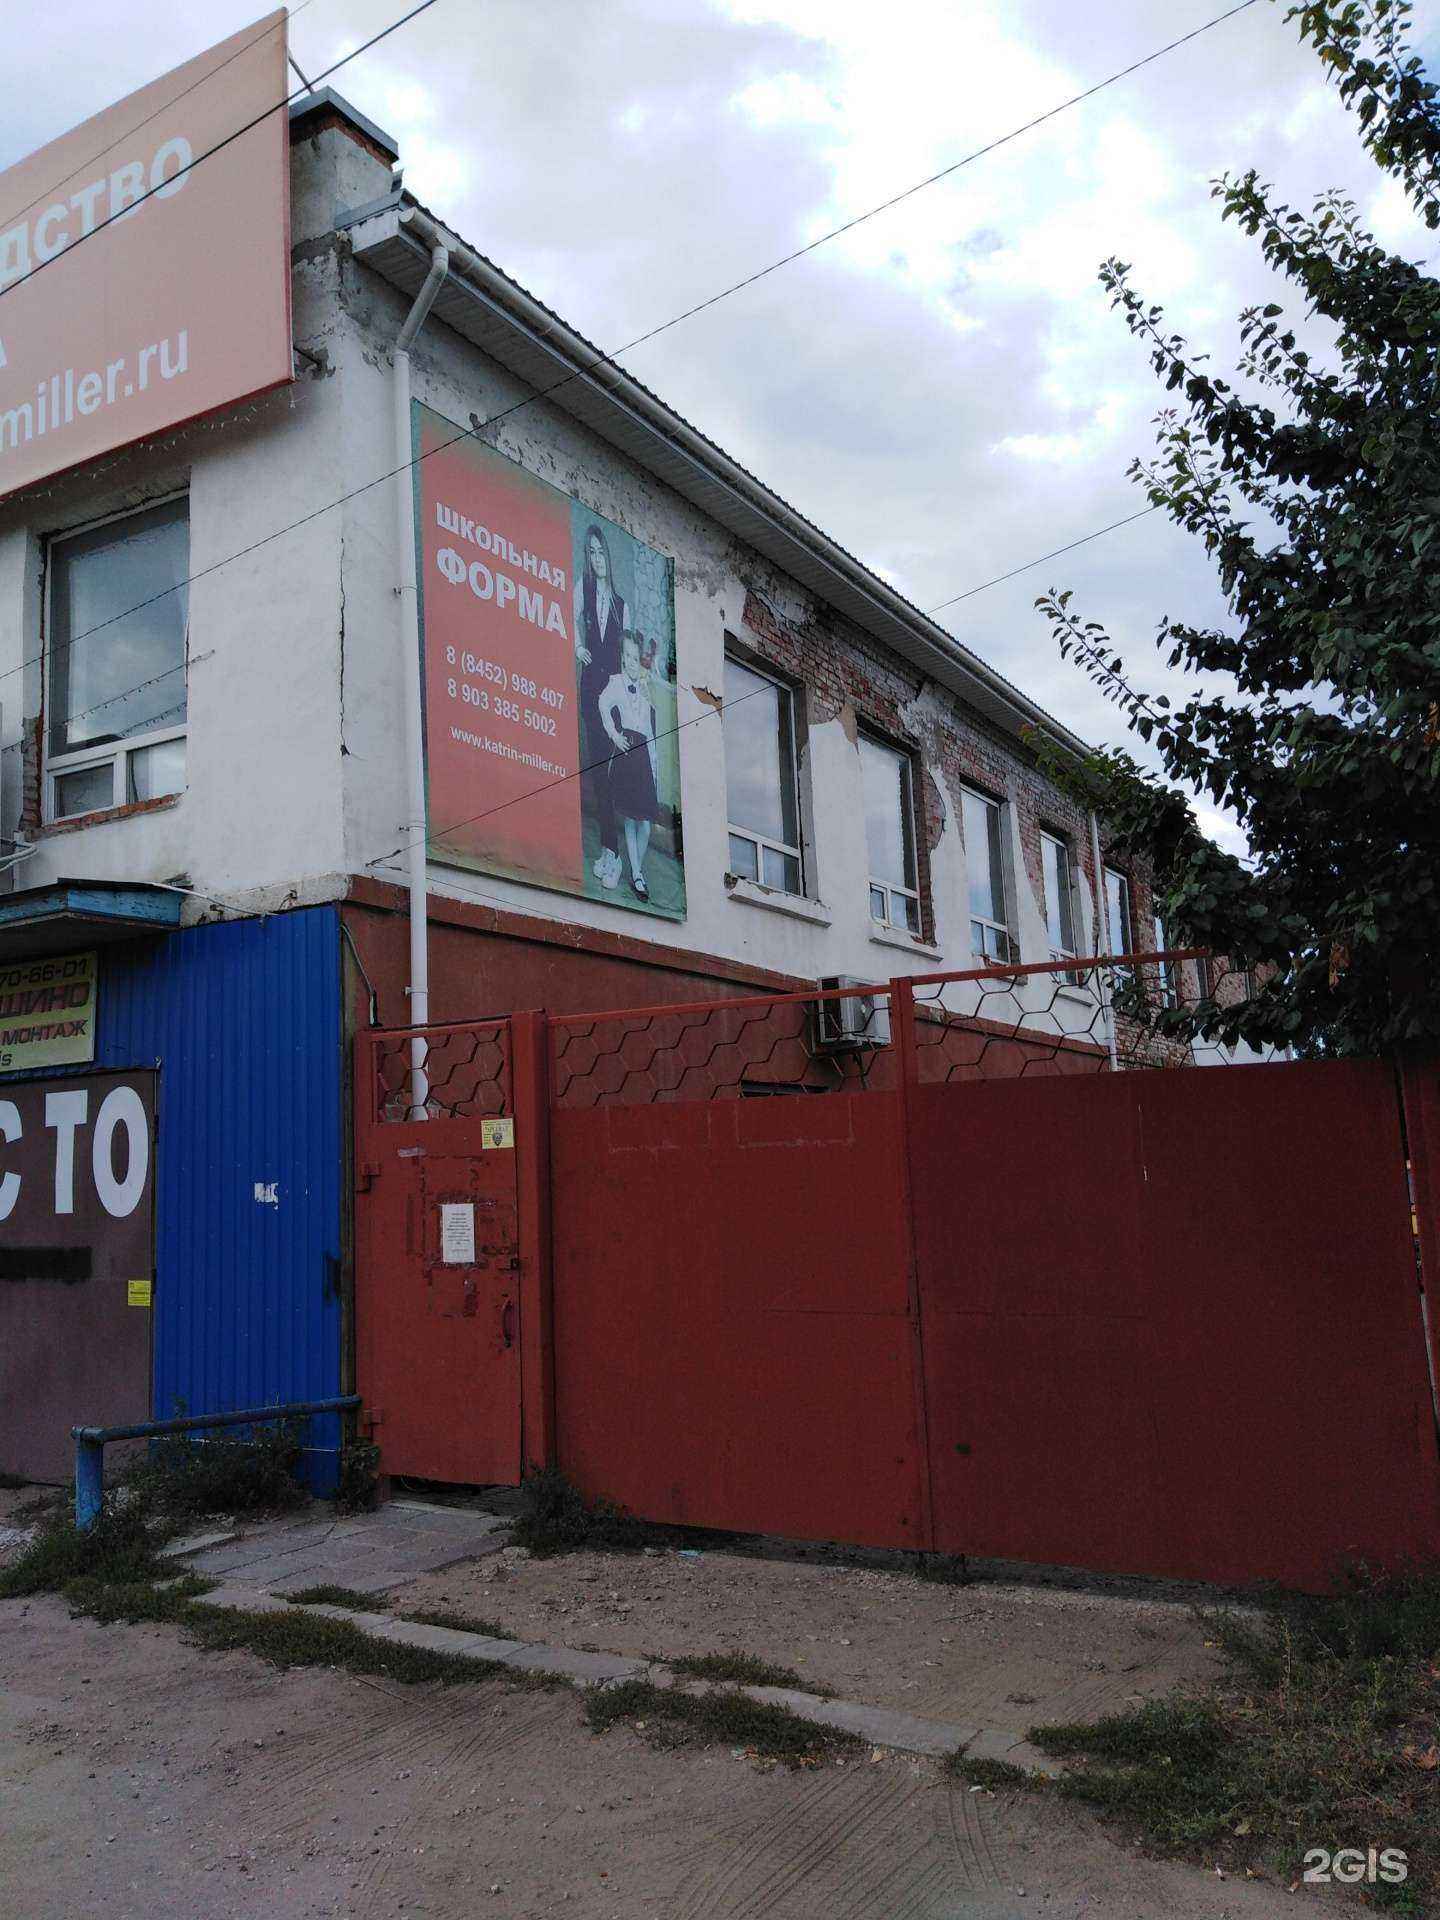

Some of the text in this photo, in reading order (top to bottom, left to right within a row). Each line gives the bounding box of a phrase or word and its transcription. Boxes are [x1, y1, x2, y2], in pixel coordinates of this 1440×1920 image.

[0, 137, 193, 293] ДСТВО
[0, 329, 188, 451] miller.ru
[436, 502, 566, 592] ШКОЛЬНАЯ
[436, 547, 568, 640] ФОРМА
[446, 645, 565, 710] 8 (8452) 988 407
[447, 678, 557, 737] 8 903 385 5002
[449, 726, 567, 778] www.katrin-miller.ru
[2, 1019, 88, 1046] МОНТАЖ
